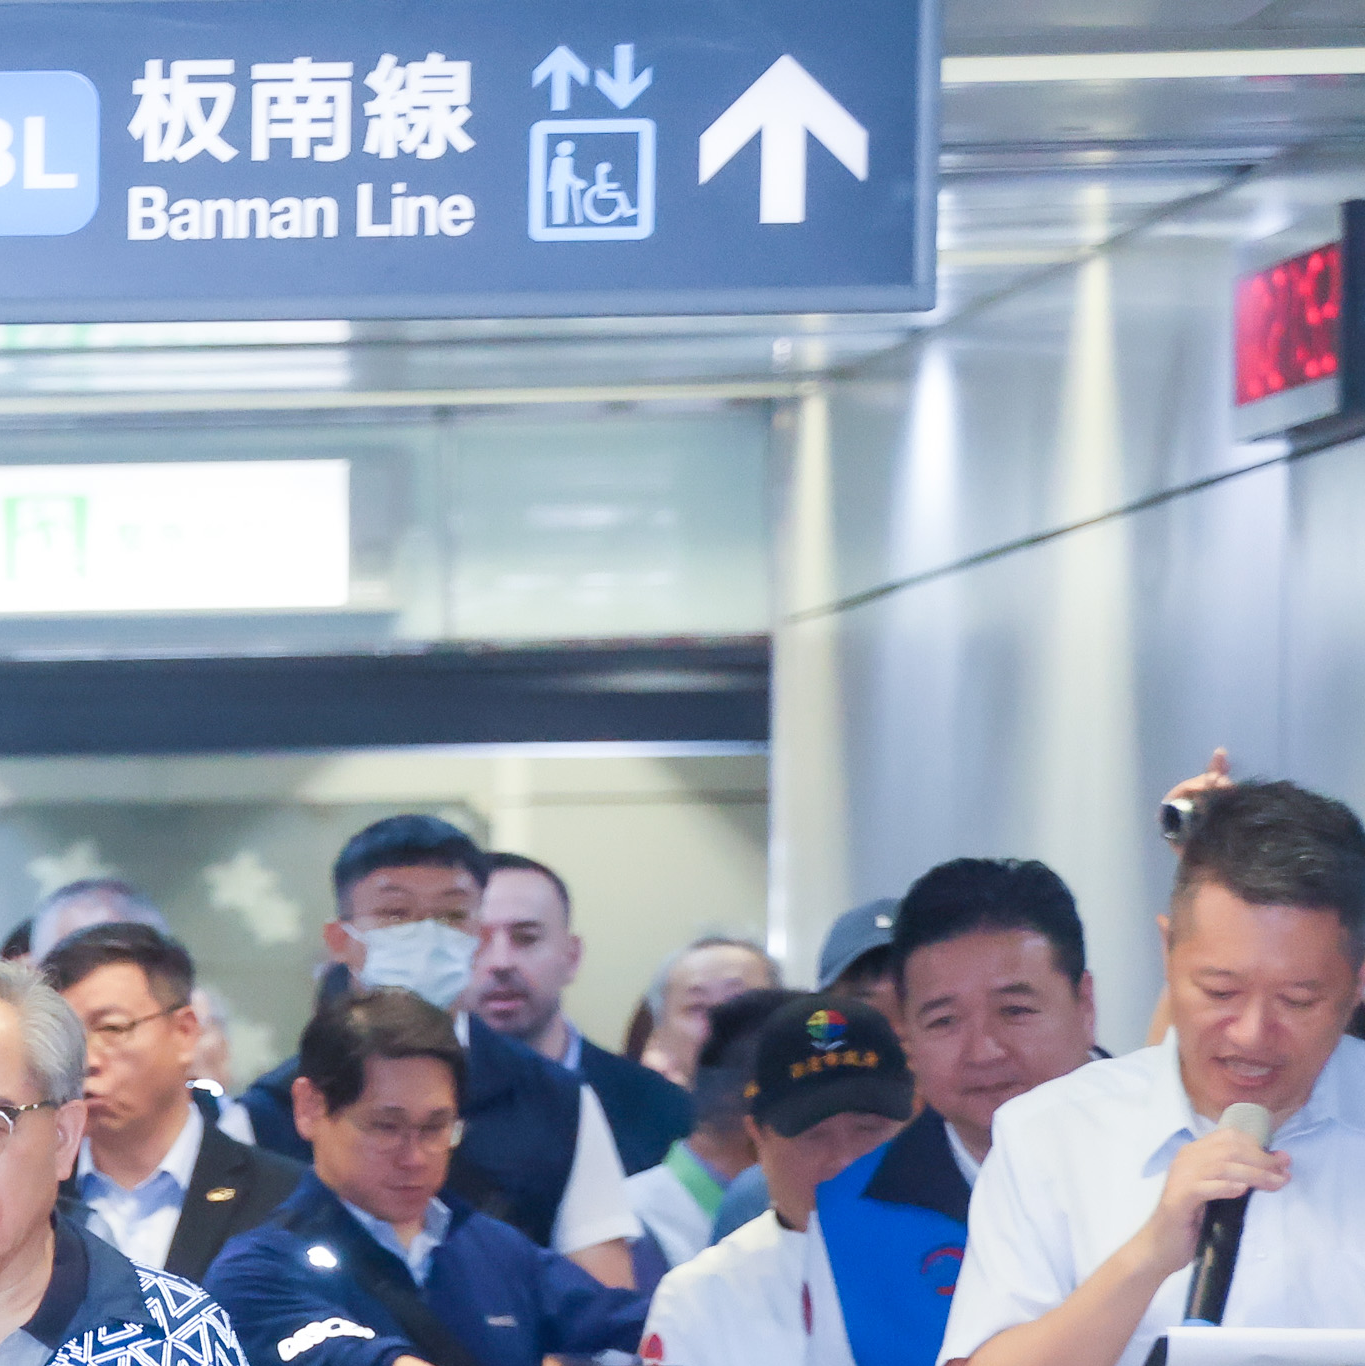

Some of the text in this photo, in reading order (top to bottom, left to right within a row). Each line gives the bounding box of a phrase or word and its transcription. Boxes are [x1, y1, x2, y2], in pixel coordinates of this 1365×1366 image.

[127, 53, 476, 163] 板南線
[126, 182, 476, 241] Bannan Line
